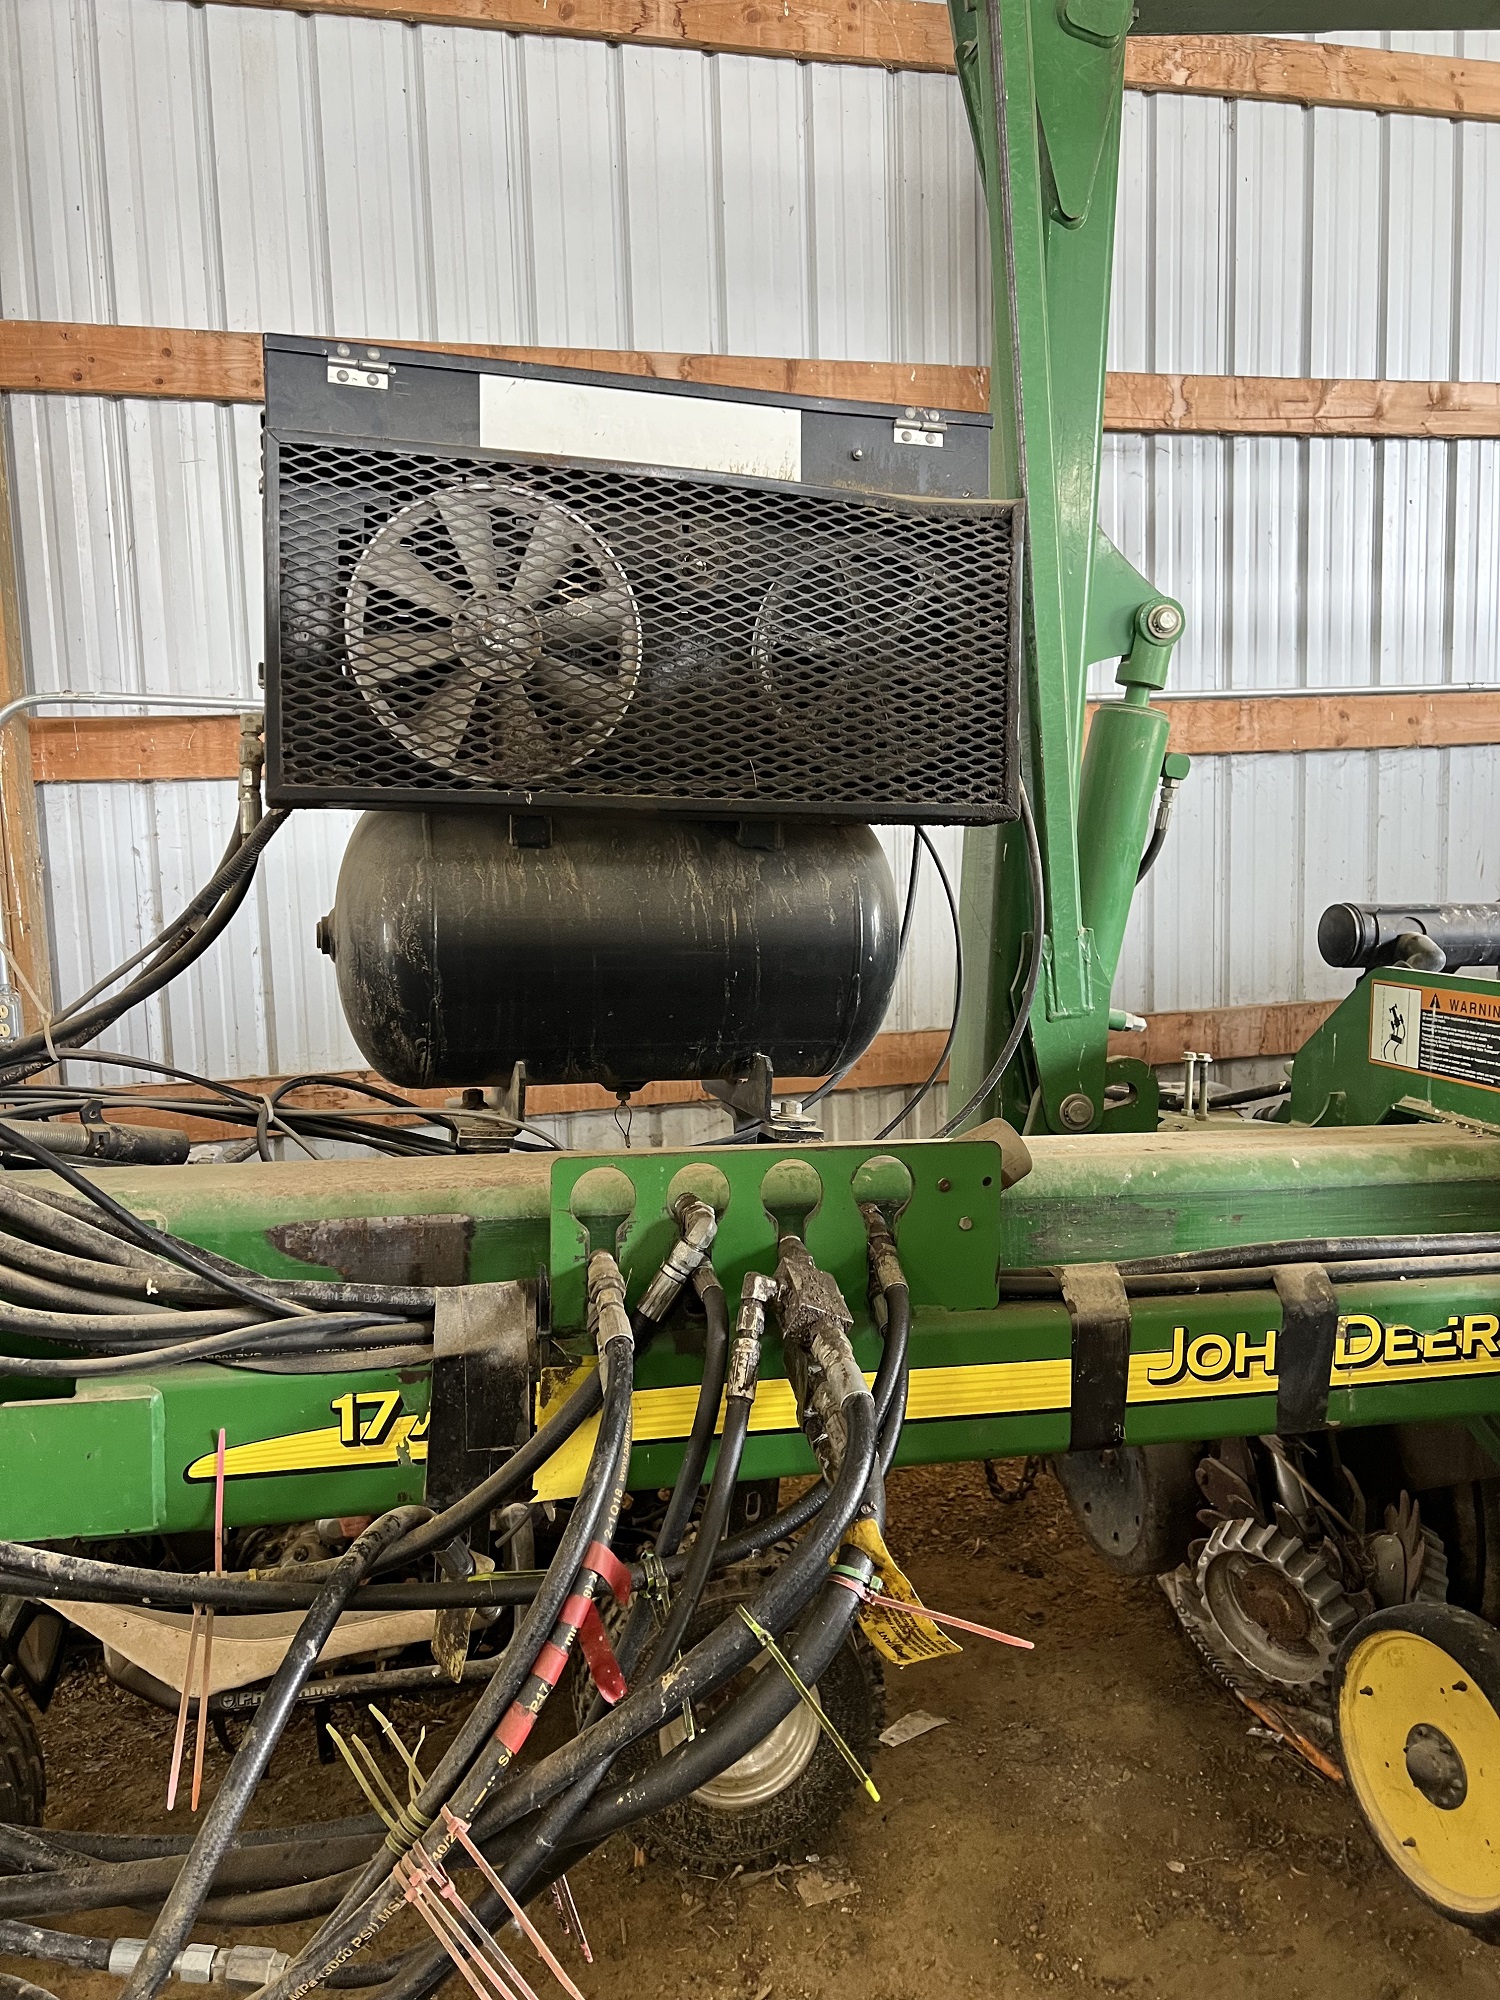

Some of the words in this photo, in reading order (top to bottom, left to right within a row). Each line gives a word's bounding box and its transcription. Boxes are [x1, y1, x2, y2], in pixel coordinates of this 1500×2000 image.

[1449, 998, 1500, 1018] WARNIN
[1148, 1326, 1277, 1383] JOH
[1334, 1314, 1500, 1369] DEER
[331, 1390, 426, 1447] 17
[433, 1832, 457, 1862] 40/2
